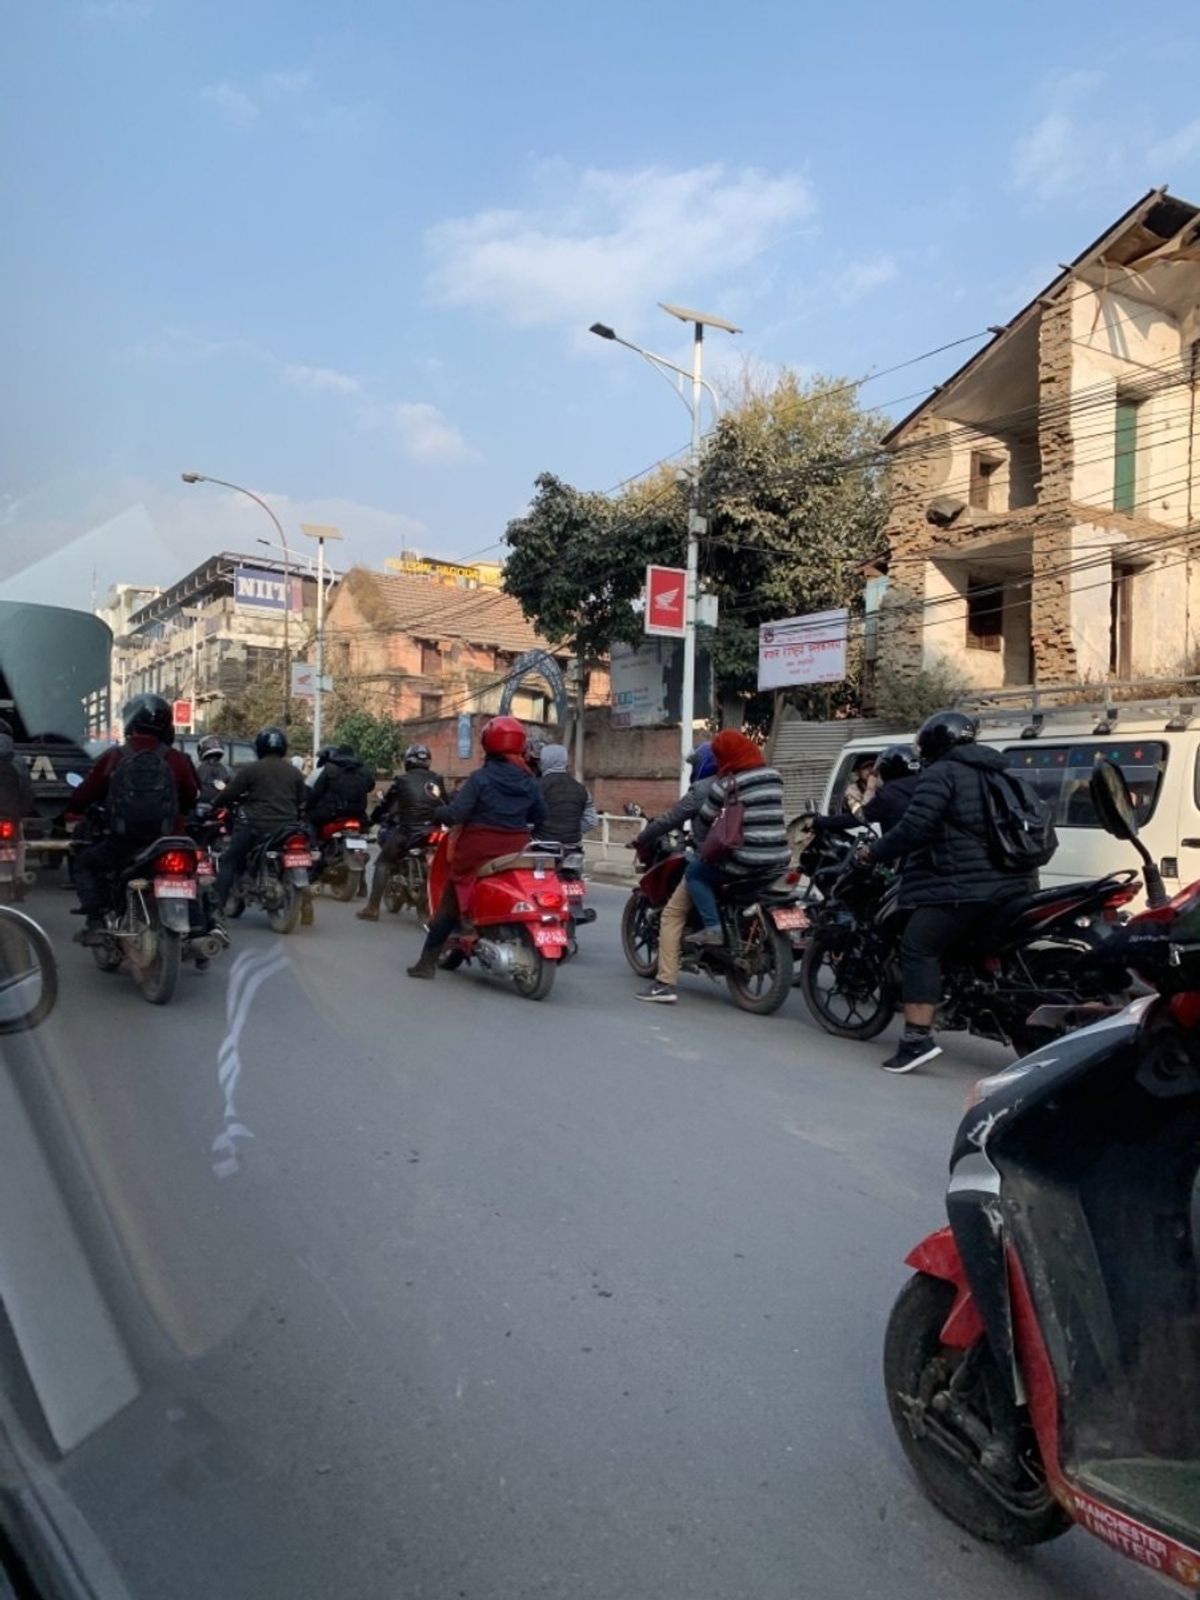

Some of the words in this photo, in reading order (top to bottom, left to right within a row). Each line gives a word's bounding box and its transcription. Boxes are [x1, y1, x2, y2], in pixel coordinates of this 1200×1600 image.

[237, 576, 291, 602] NIIT
[1074, 1496, 1167, 1558] MANCHESTER
[1085, 1514, 1161, 1569] UNITED
